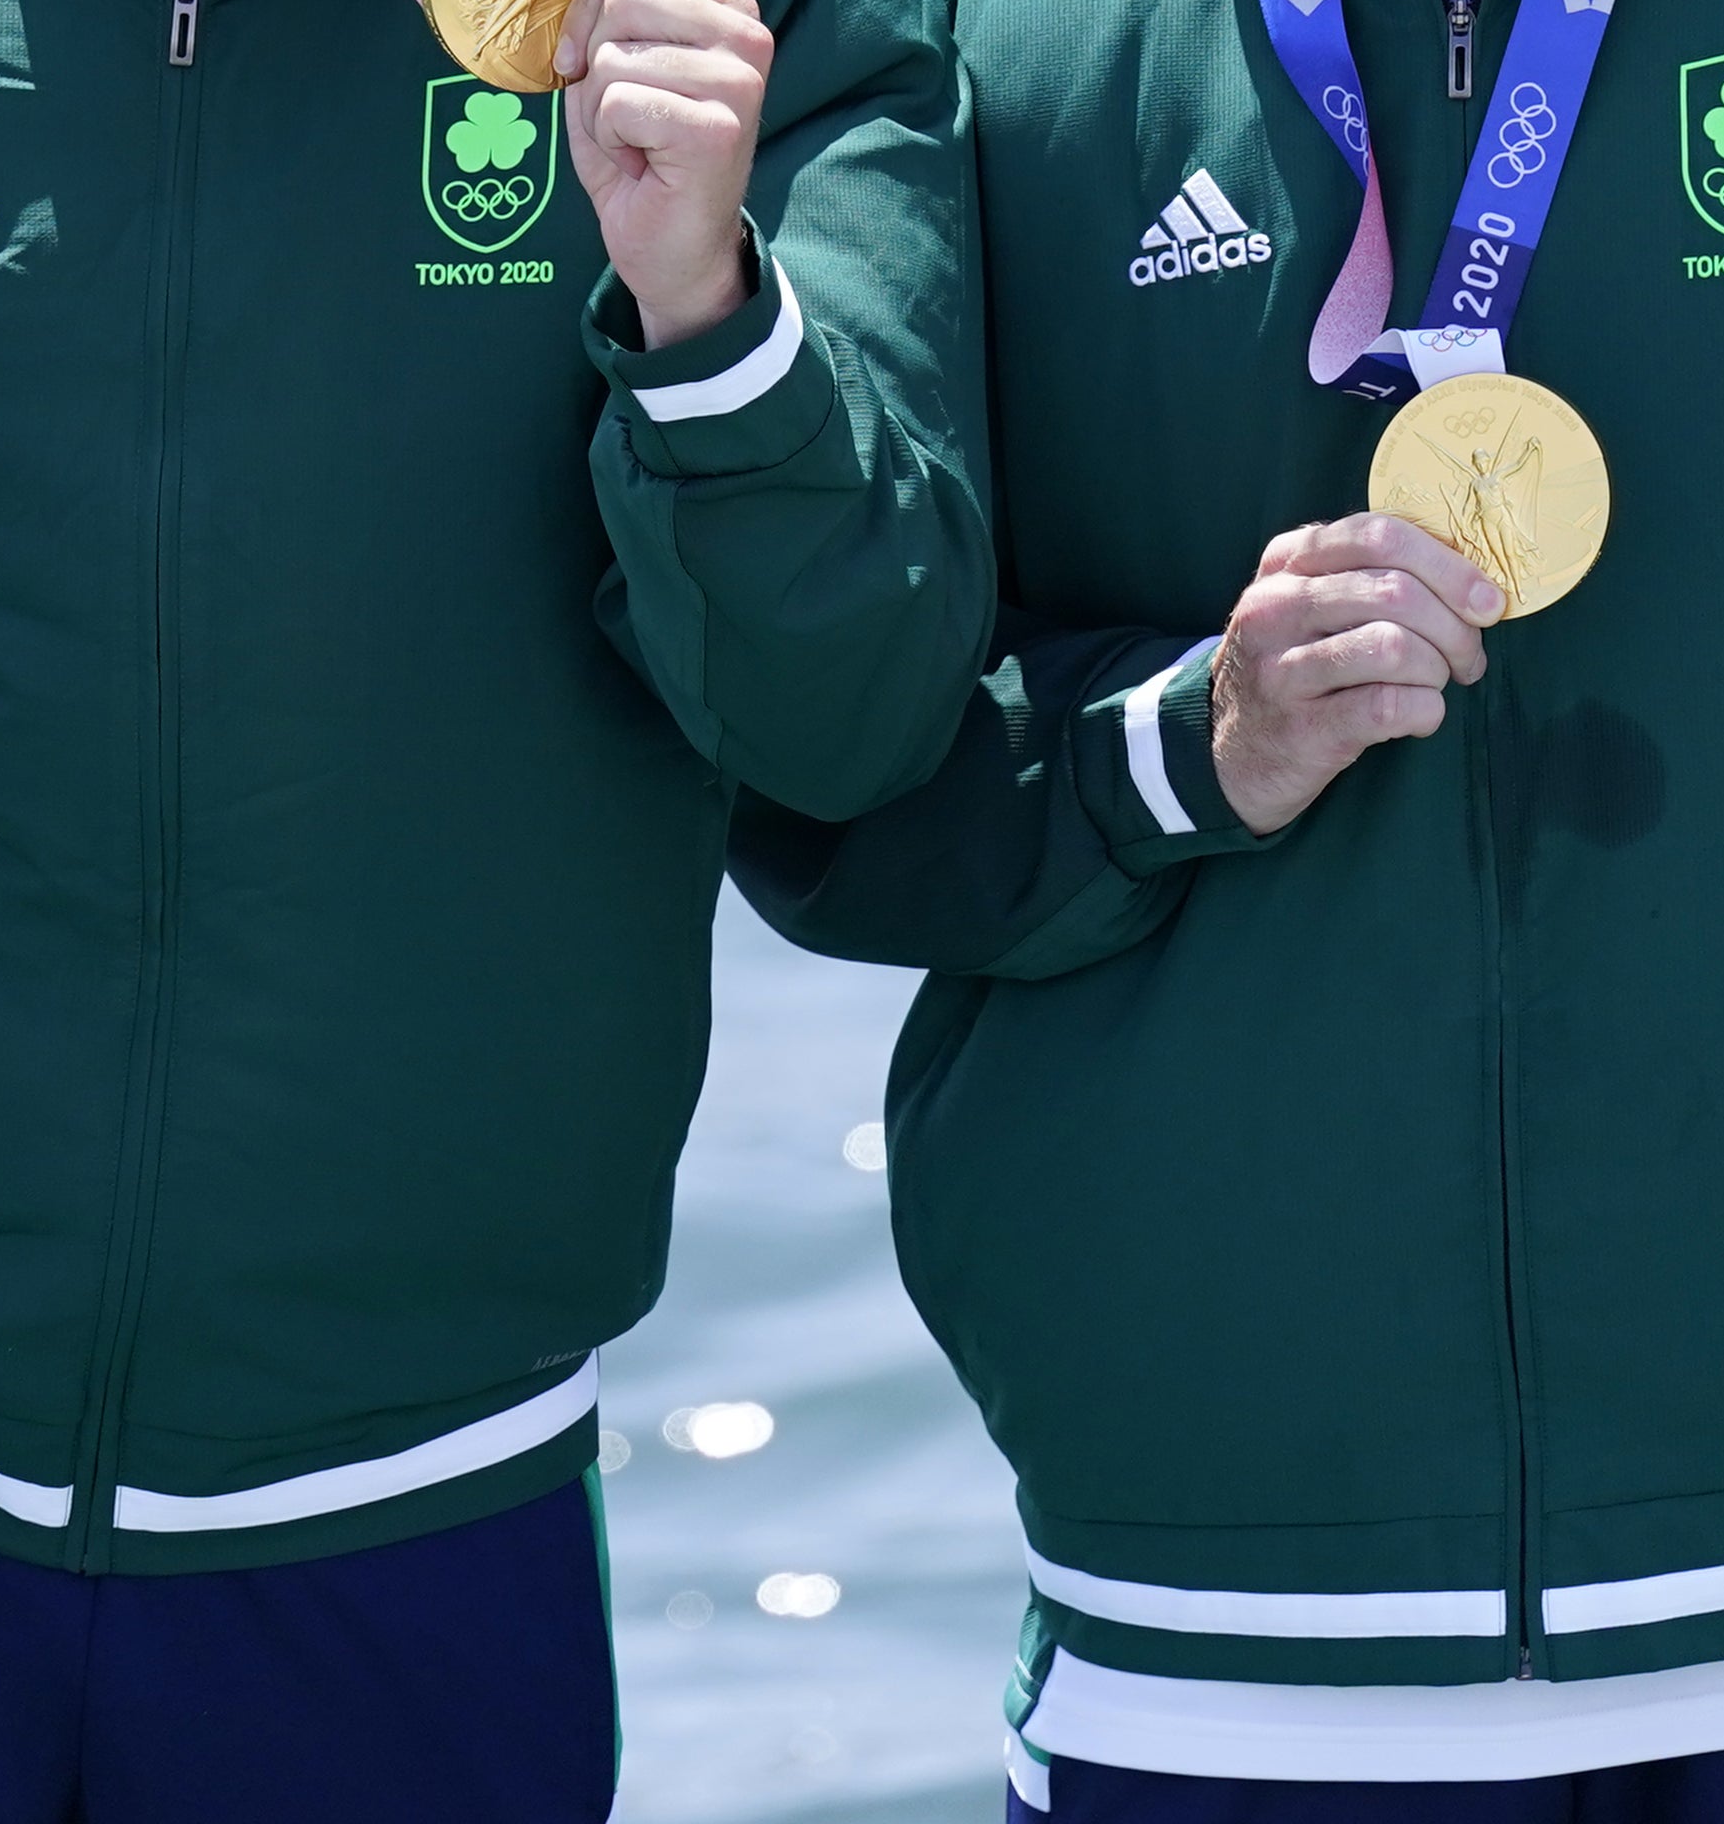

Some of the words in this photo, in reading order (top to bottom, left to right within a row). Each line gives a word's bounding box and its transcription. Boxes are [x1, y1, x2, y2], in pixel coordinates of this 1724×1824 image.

[415, 262, 494, 286] TOKYO
[500, 260, 554, 284] 2020
[1129, 232, 1273, 287] adidas
[1452, 211, 1516, 318] 2020
